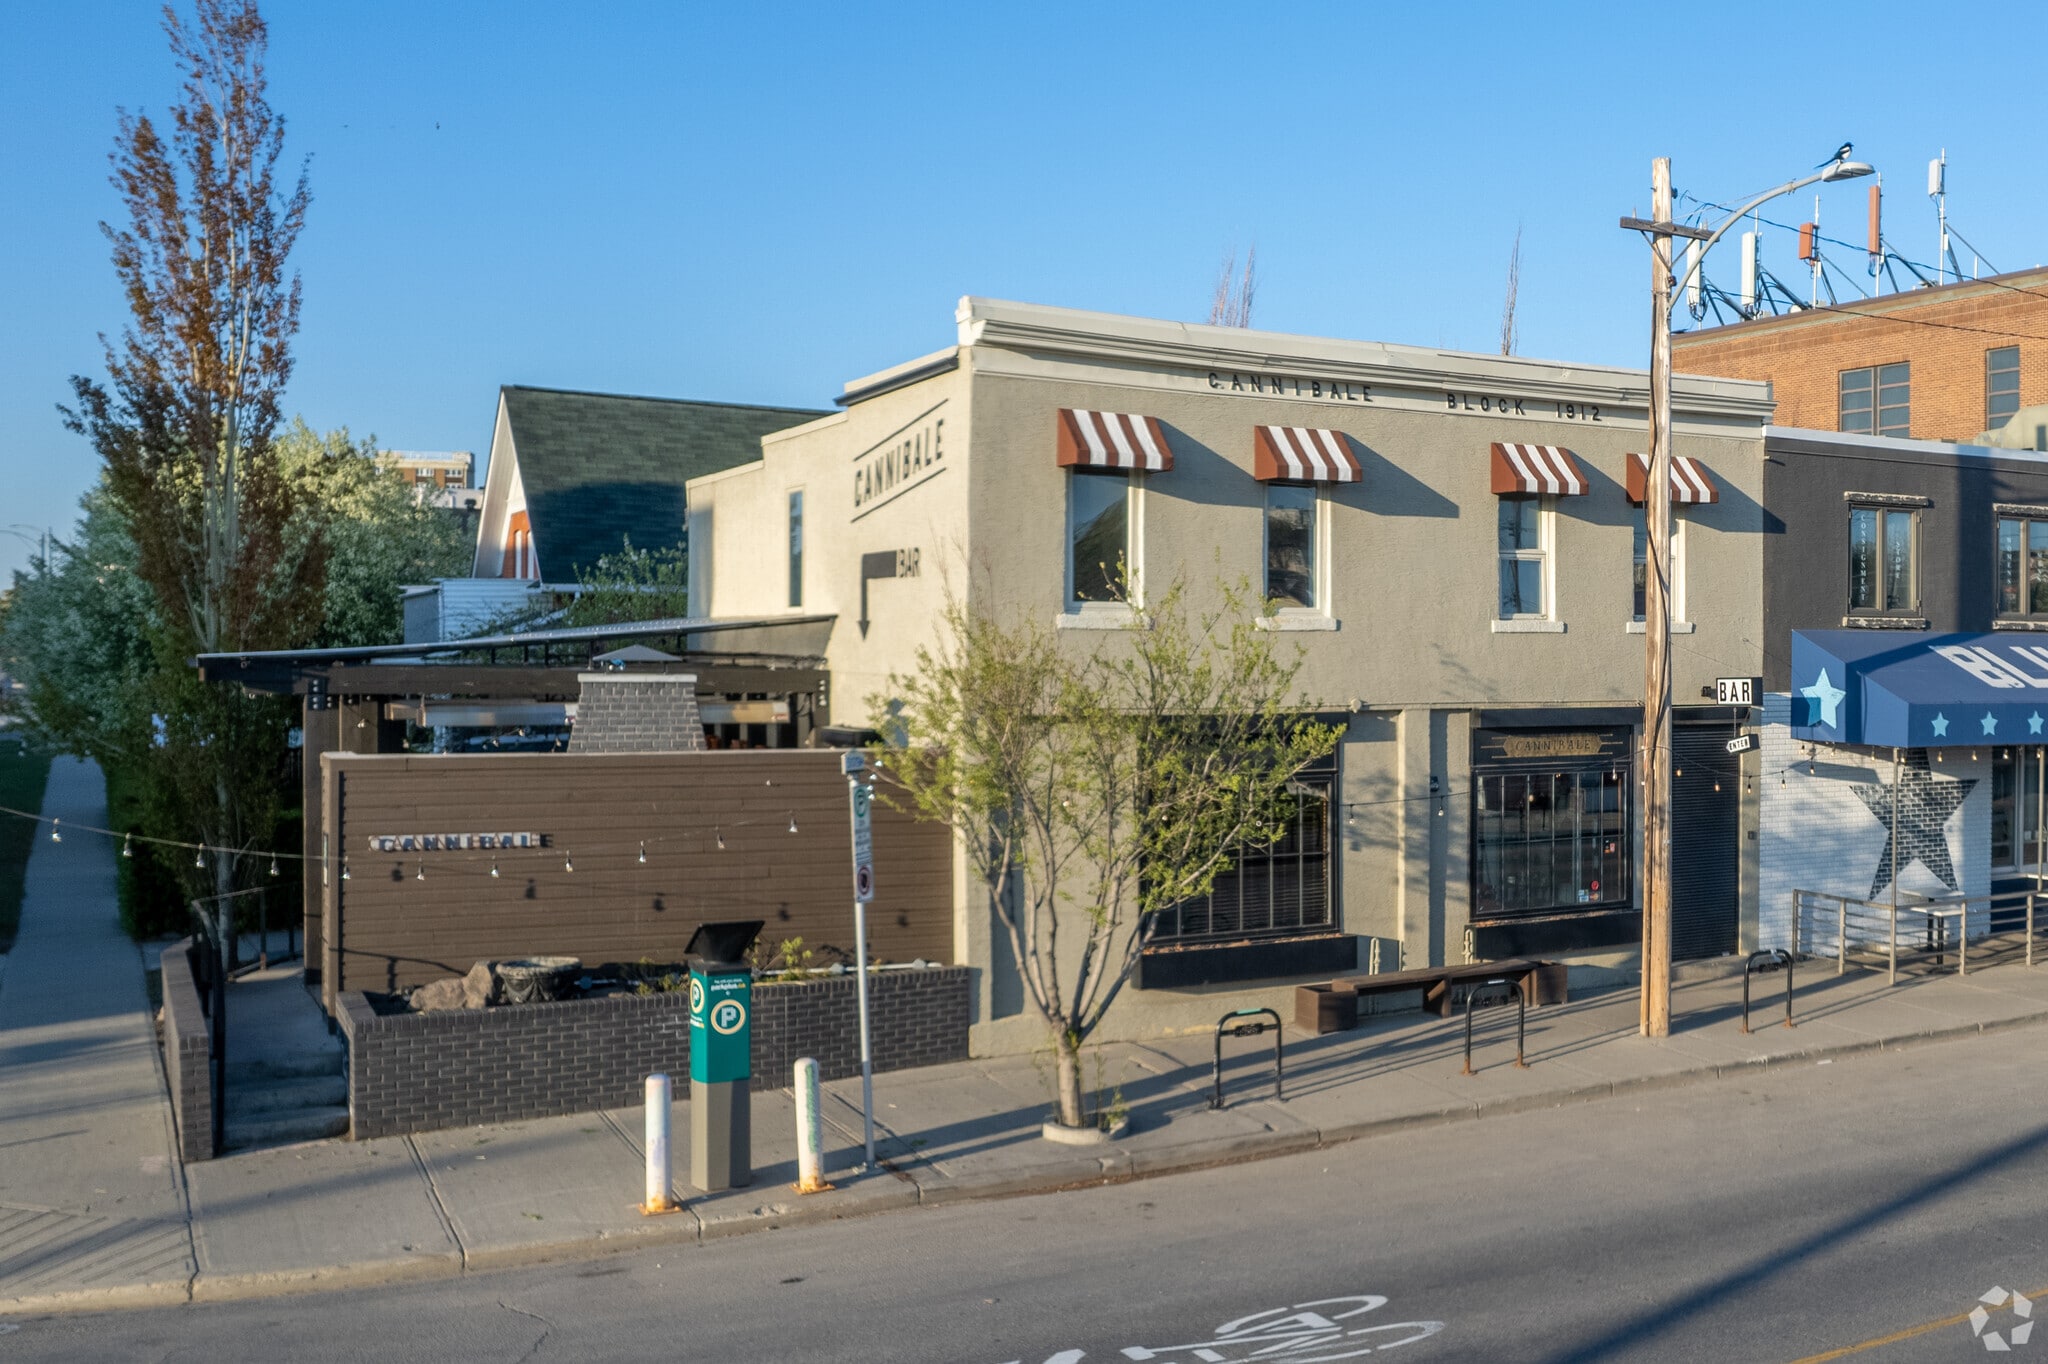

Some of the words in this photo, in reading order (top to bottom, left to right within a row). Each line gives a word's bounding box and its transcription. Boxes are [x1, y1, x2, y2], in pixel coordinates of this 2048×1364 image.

[1208, 372, 1373, 402] CANNIBALE
[1447, 393, 1525, 415] BLOCK
[1556, 402, 1602, 421] 1912
[854, 418, 944, 508] CANNIBALE
[899, 547, 920, 577] BAR
[1719, 681, 1750, 702] BAR
[1728, 738, 1748, 751] ENTER
[721, 1006, 737, 1028] P
